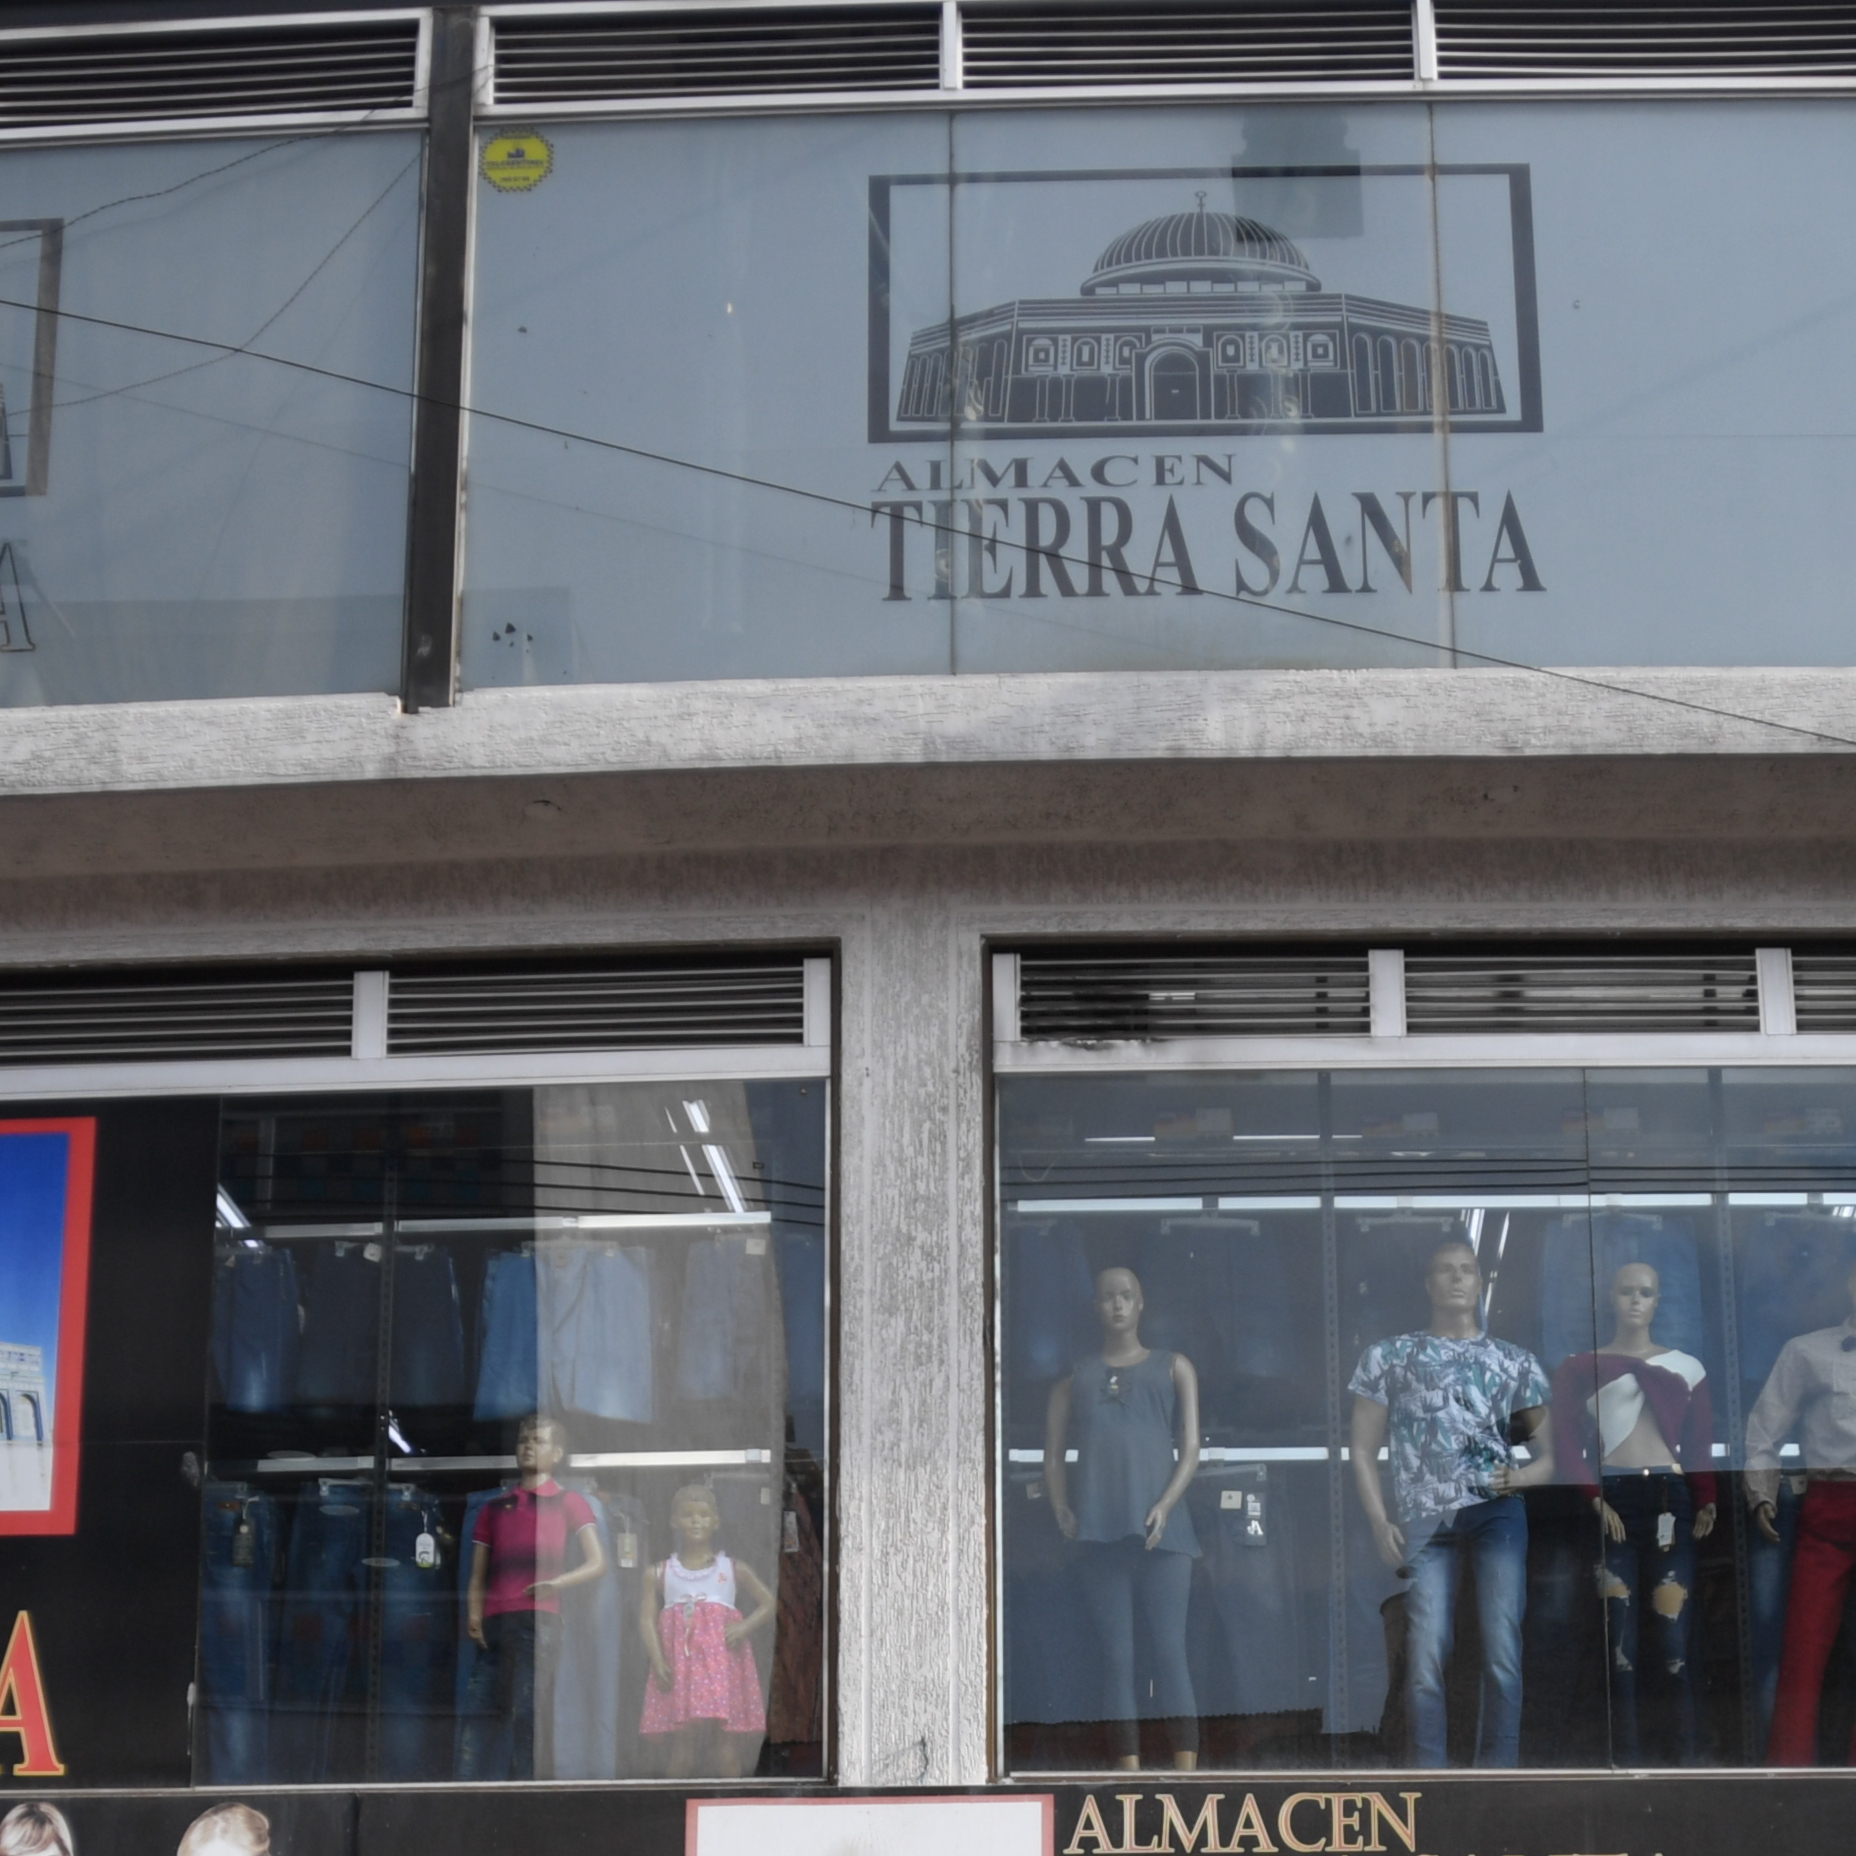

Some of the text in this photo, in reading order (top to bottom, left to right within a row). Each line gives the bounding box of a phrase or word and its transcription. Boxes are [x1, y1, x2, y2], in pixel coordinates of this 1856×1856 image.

[871, 453, 1238, 493] ALMACEN
[870, 489, 1548, 601] TIERRA SANTA
[1062, 1791, 1422, 1856] ALMACEN
